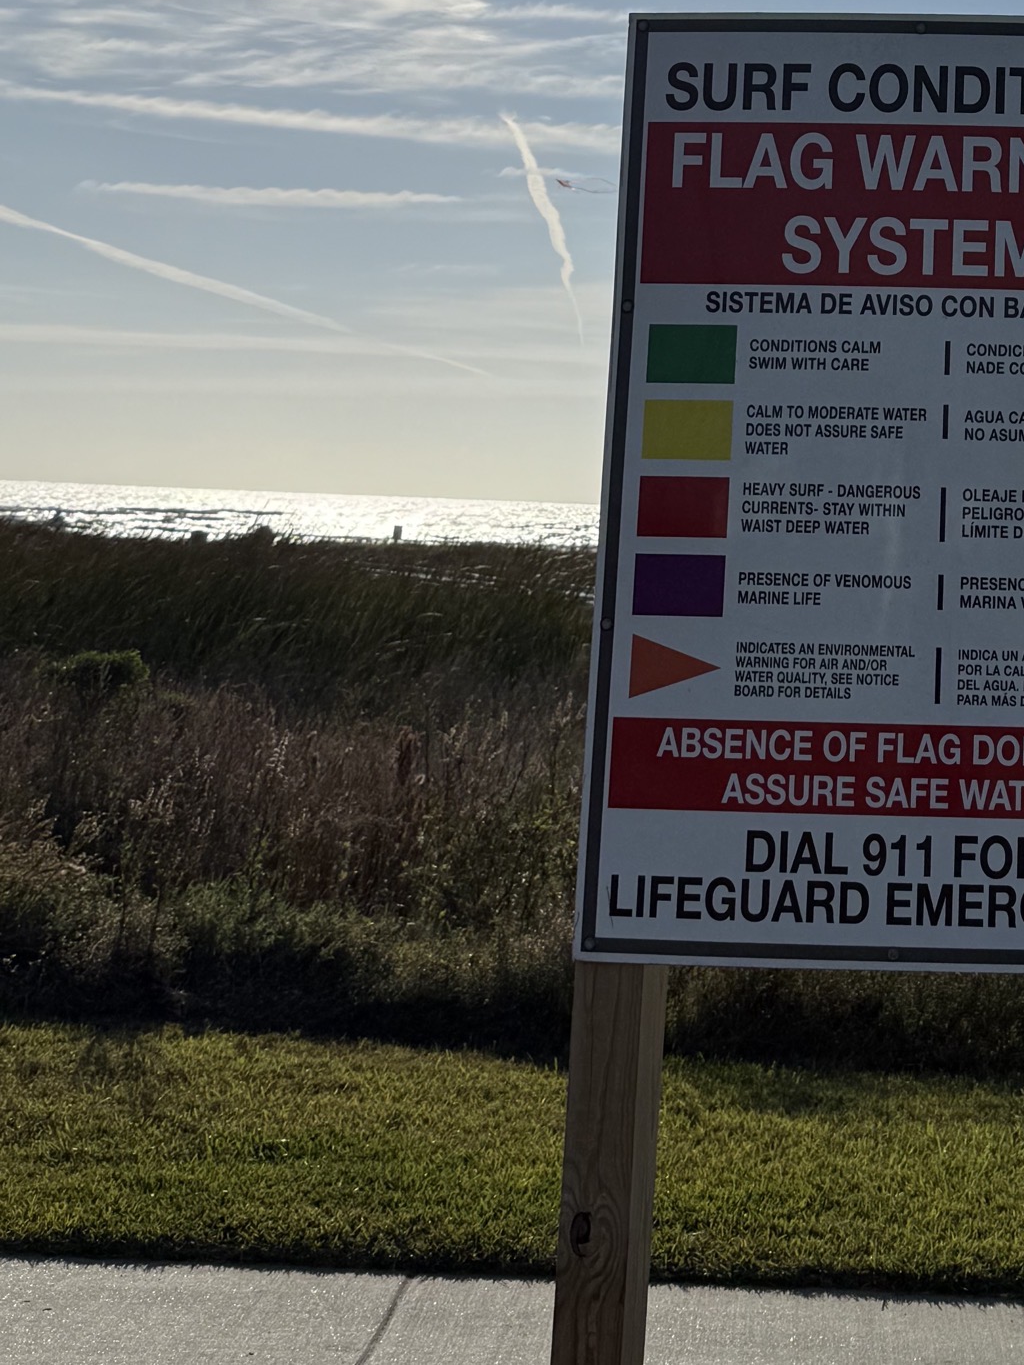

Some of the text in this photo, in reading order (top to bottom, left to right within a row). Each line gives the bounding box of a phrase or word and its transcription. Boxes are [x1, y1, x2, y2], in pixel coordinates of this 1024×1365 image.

[666, 62, 811, 111] SURF
[672, 133, 833, 190] FLAG
[706, 291, 812, 313] SISTEMA
[821, 293, 852, 314] DE
[860, 294, 932, 316] AVISO
[942, 295, 994, 317] CON
[750, 339, 880, 353] CONDITIONS CALM
[749, 357, 869, 371] SWIM WITH CARE
[967, 361, 1004, 374] NADE
[747, 405, 926, 421] CALM TO MODERATE WATER
[965, 410, 1004, 423] AGUA
[746, 423, 903, 439] DOES NOT ASSURE SAFE
[965, 428, 984, 441] NO
[745, 441, 788, 455] WATER
[743, 482, 785, 496] HEAVY
[789, 483, 824, 496] SURF
[838, 484, 920, 499] DANGEROUS
[963, 489, 1017, 502] OLEAJE
[823, 502, 854, 515] STAY
[859, 503, 905, 517] WITHIN
[741, 519, 870, 535] WAIST DEEP WATER
[962, 522, 1008, 538] LÍMITE
[739, 572, 911, 589] PRESENCE OF VENOMOUS
[738, 591, 821, 605] MARINE LIFE
[960, 595, 1016, 609] MARINA
[737, 642, 915, 657] INDICATES AN ENVIRONMENTAL
[959, 650, 998, 661] INDICA
[1002, 651, 1018, 661] UN
[736, 656, 887, 671] WARNING FOR AIR AND/OR
[958, 664, 982, 675] POR
[986, 665, 1000, 676] LA
[735, 671, 899, 686] WATER QUALITY, SEE NOTICE
[958, 679, 980, 690] DEL
[984, 680, 1019, 692] AGUA.
[734, 685, 851, 699] BOARD FOR DETAILS
[957, 694, 987, 706] PARA
[992, 693, 1016, 706] MÁS
[657, 727, 812, 760] ABSENCE
[824, 731, 867, 762] OF
[878, 733, 960, 765] FLAG
[722, 773, 855, 806] ASSURE
[866, 777, 948, 809] SAFE
[746, 830, 848, 875] DIAL
[863, 834, 931, 877] 911
[609, 875, 869, 924] LIFEGUARD
